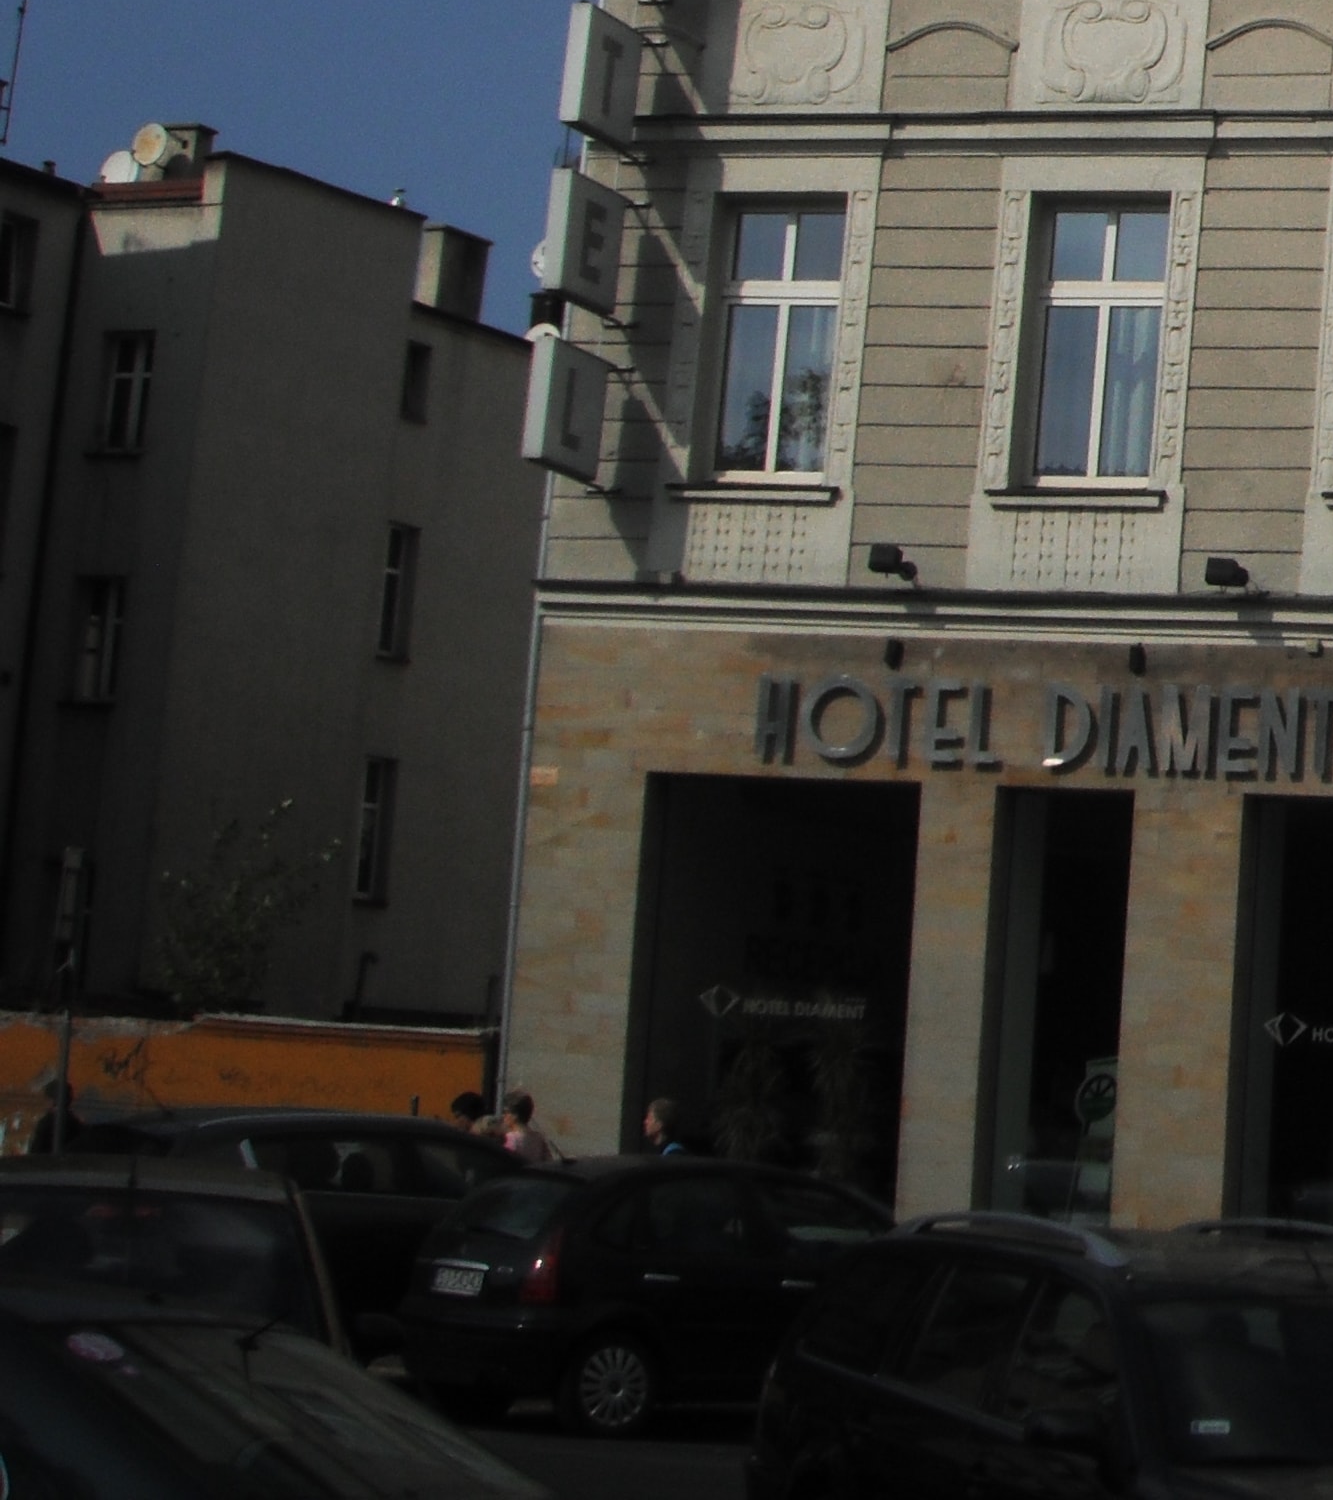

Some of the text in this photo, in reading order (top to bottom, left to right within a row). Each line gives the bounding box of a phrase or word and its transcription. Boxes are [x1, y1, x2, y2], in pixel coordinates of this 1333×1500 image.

[756, 674, 1001, 770] HOTEL
[742, 997, 867, 1020] HOTEL DIAMENT
